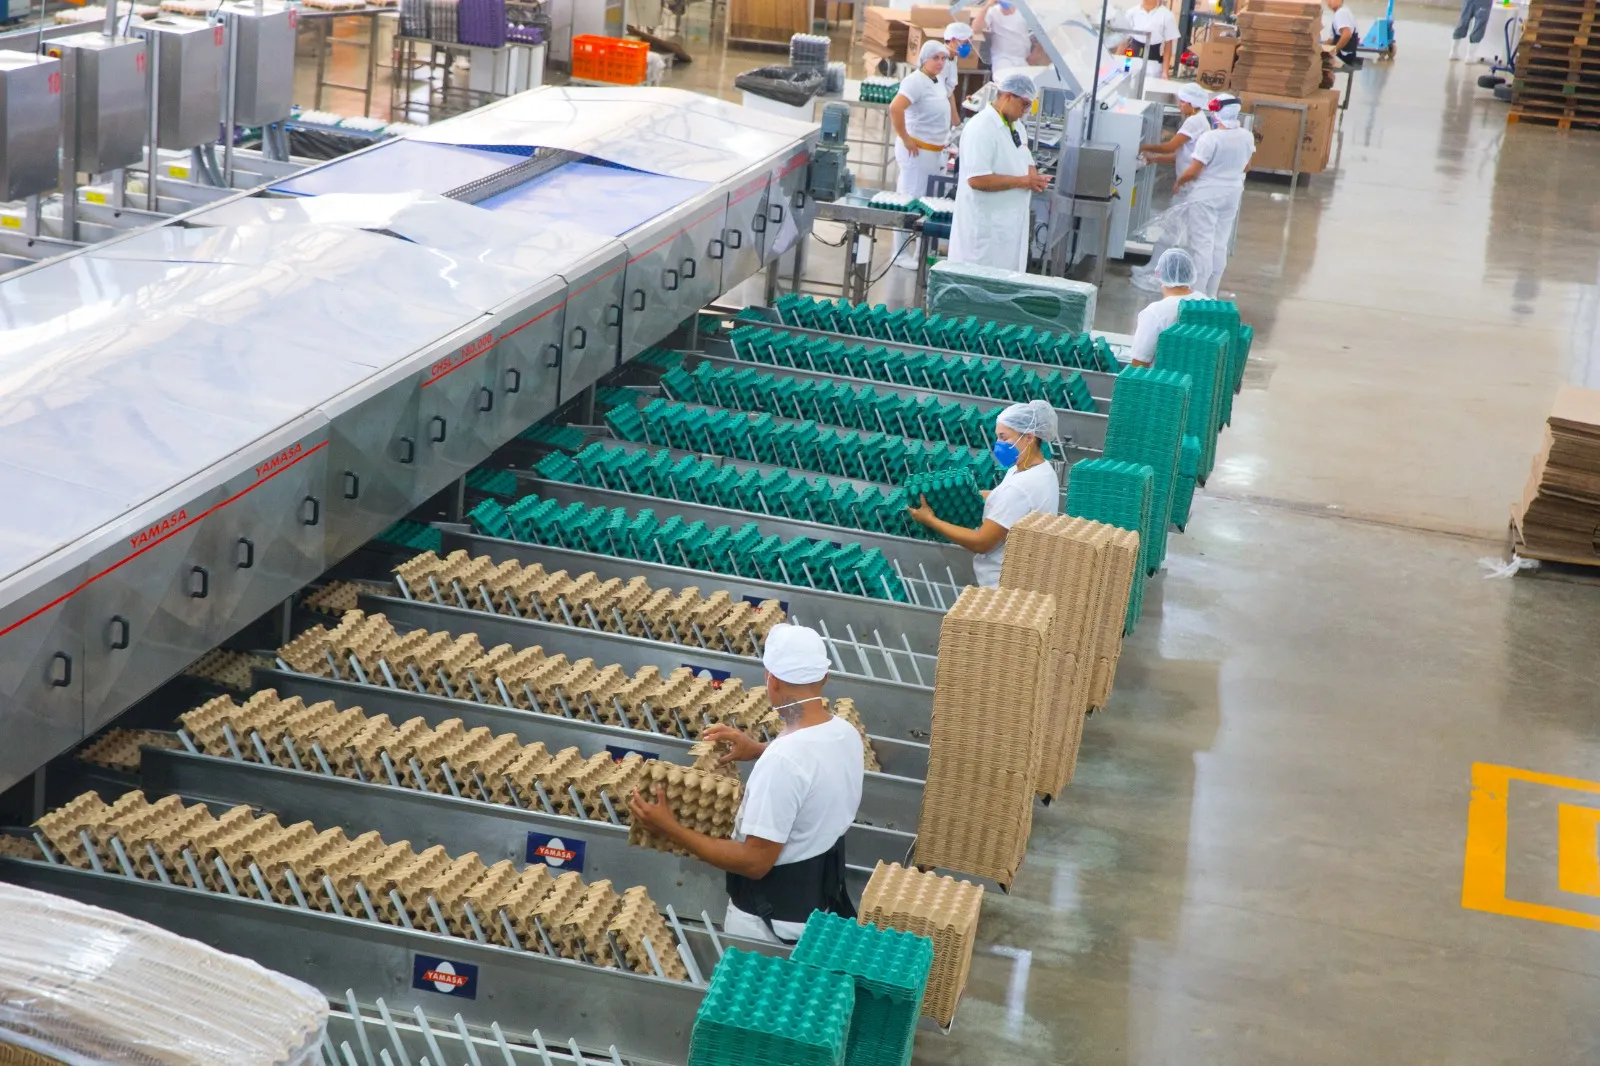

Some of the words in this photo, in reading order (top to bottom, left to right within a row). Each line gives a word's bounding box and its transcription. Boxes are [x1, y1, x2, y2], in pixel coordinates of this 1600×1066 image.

[48, 71, 61, 94] 10
[255, 442, 302, 477] YAMASA
[130, 509, 187, 549] YAMASA
[539, 847, 572, 860] YAMASA
[427, 971, 463, 985] YAMASA
